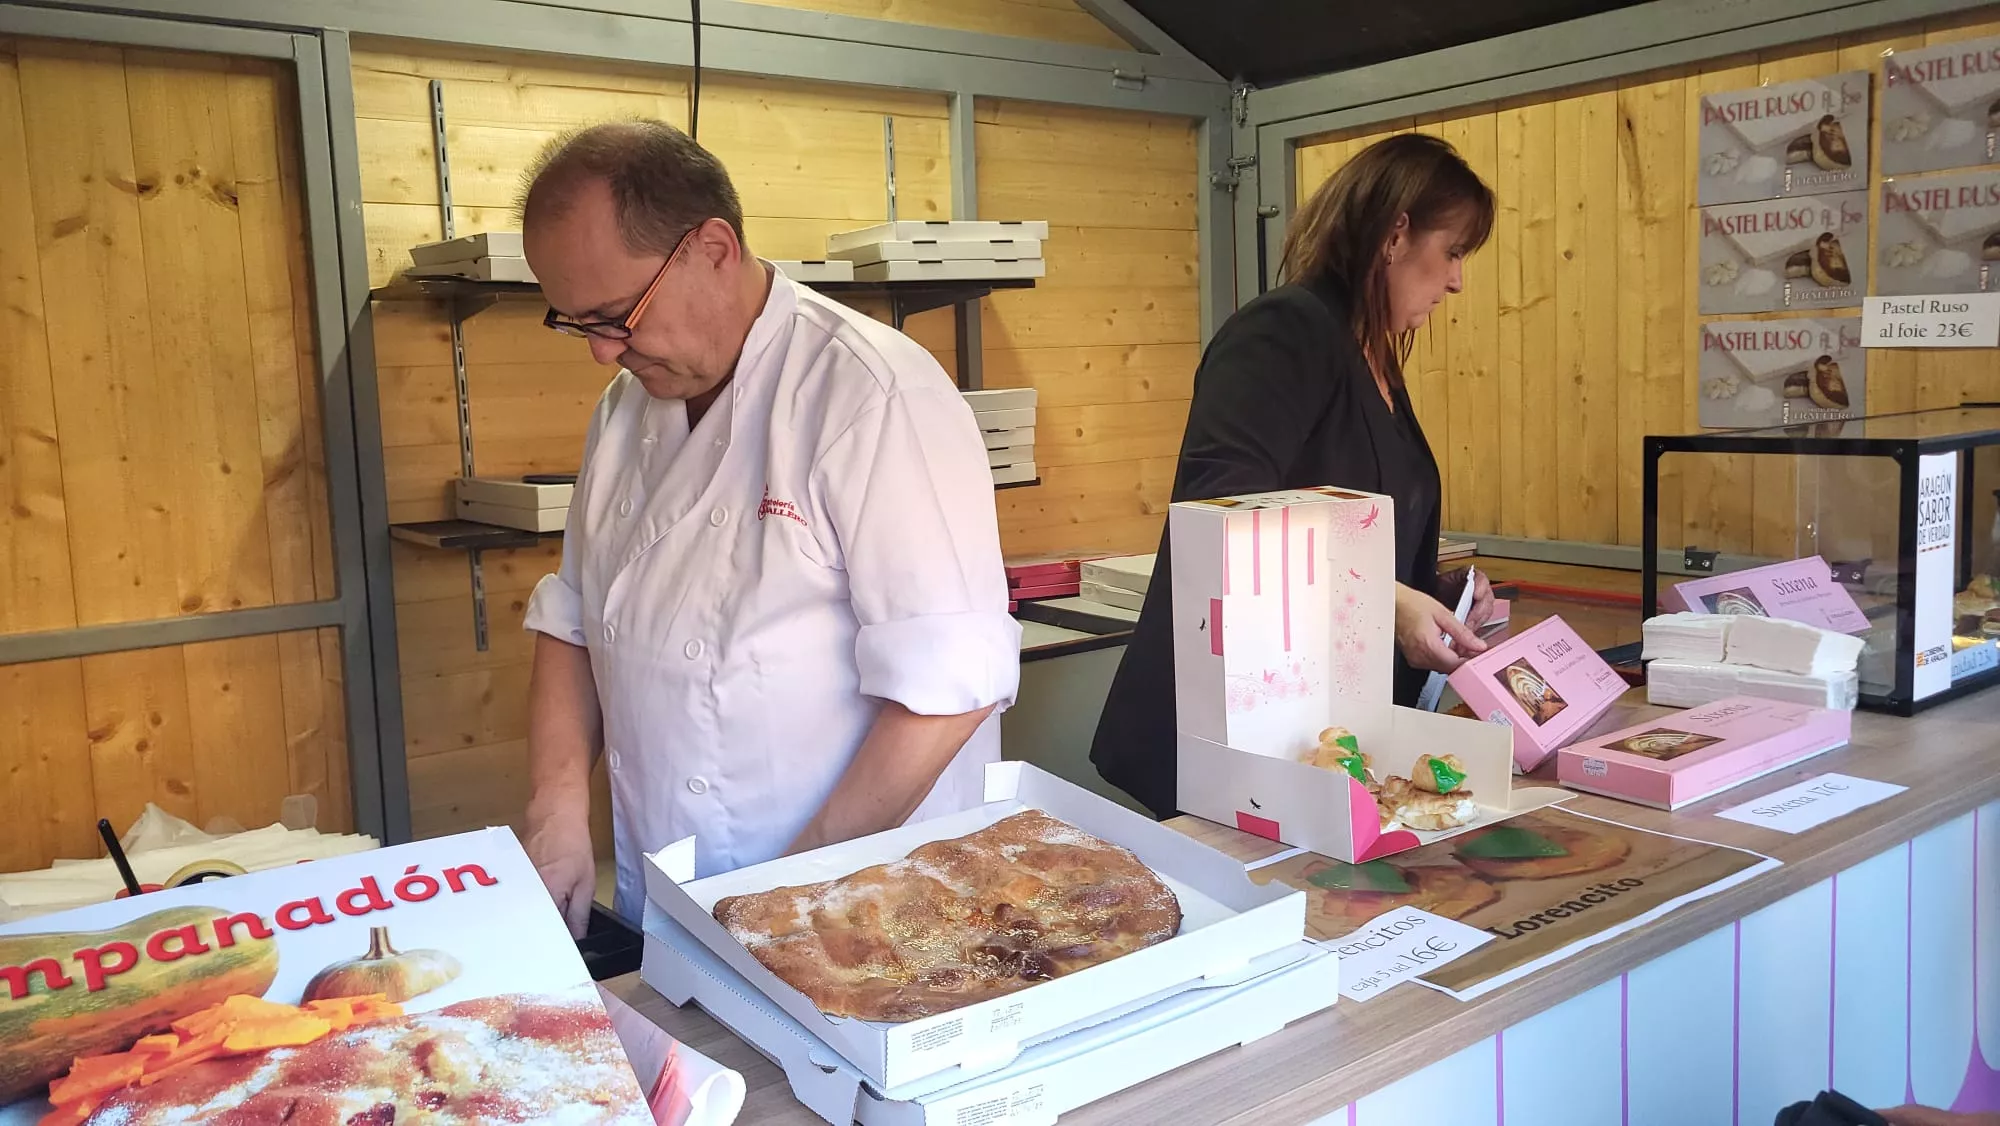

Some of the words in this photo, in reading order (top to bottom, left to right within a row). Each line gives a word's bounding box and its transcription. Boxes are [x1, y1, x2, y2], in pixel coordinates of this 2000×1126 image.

[1888, 56, 1958, 88] PASTEL
[1704, 99, 1762, 127] PASTEL
[1766, 90, 1815, 118] RUSO
[1885, 188, 1955, 214] PASTEL
[1704, 213, 1761, 238] PASTEL
[1765, 207, 1814, 232] RUSO
[1881, 300, 1925, 315] Pastel
[1930, 300, 1969, 313] Ruso
[1704, 331, 1761, 351] PASTEL
[1764, 329, 1813, 350] RUSO
[1879, 323, 1893, 338] al
[1899, 323, 1928, 338] foie
[1936, 322, 1975, 338] 23€
[1919, 469, 1952, 499] ARAGÓN
[1918, 496, 1951, 527] SABOR
[1918, 529, 1927, 546] DE
[1751, 795, 1815, 818] Sixena
[1486, 877, 1645, 941] Lorencito
[1397, 935, 1458, 964] 16€
[1376, 970, 1391, 978] 5
[1388, 962, 1413, 973] ud
[1351, 975, 1383, 992] caja
